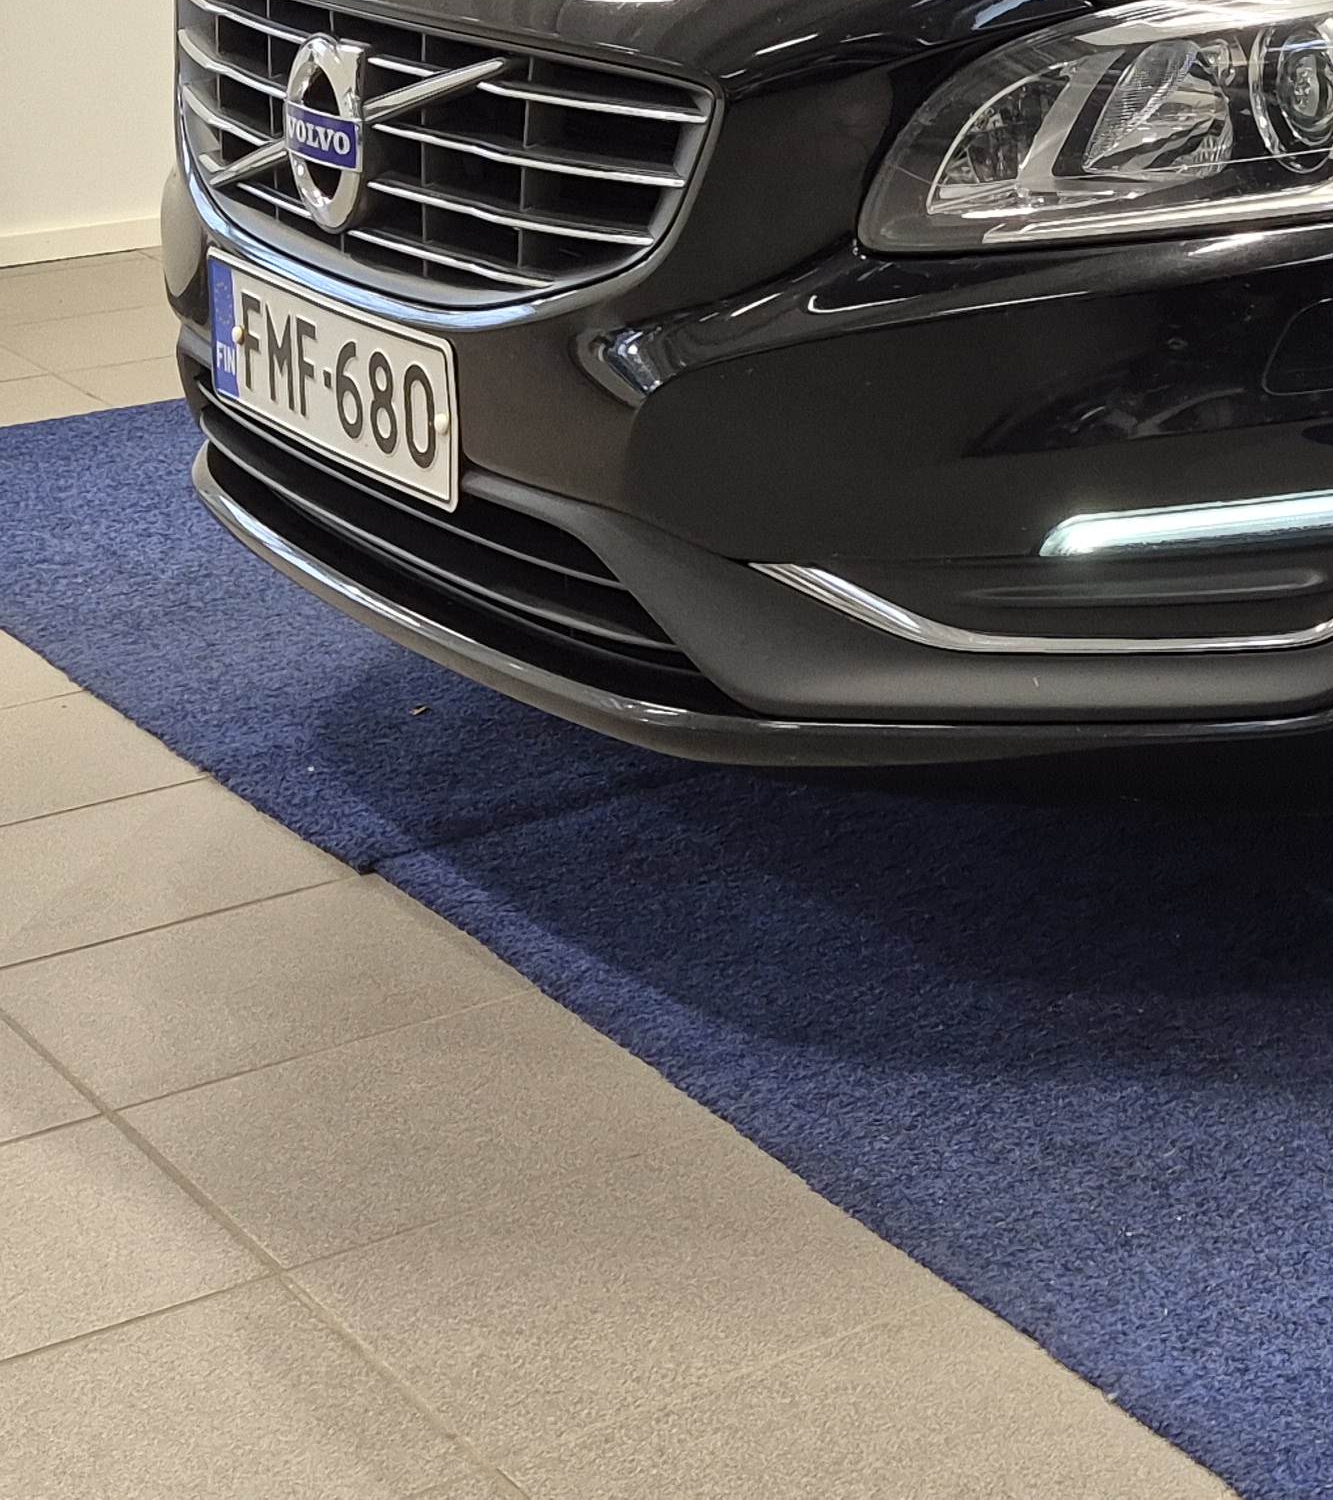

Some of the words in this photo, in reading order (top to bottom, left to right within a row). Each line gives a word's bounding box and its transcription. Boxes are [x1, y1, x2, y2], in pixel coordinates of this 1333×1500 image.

[286, 113, 352, 156] VOLVO
[216, 341, 237, 377] FIN
[240, 291, 437, 470] FMF-680
